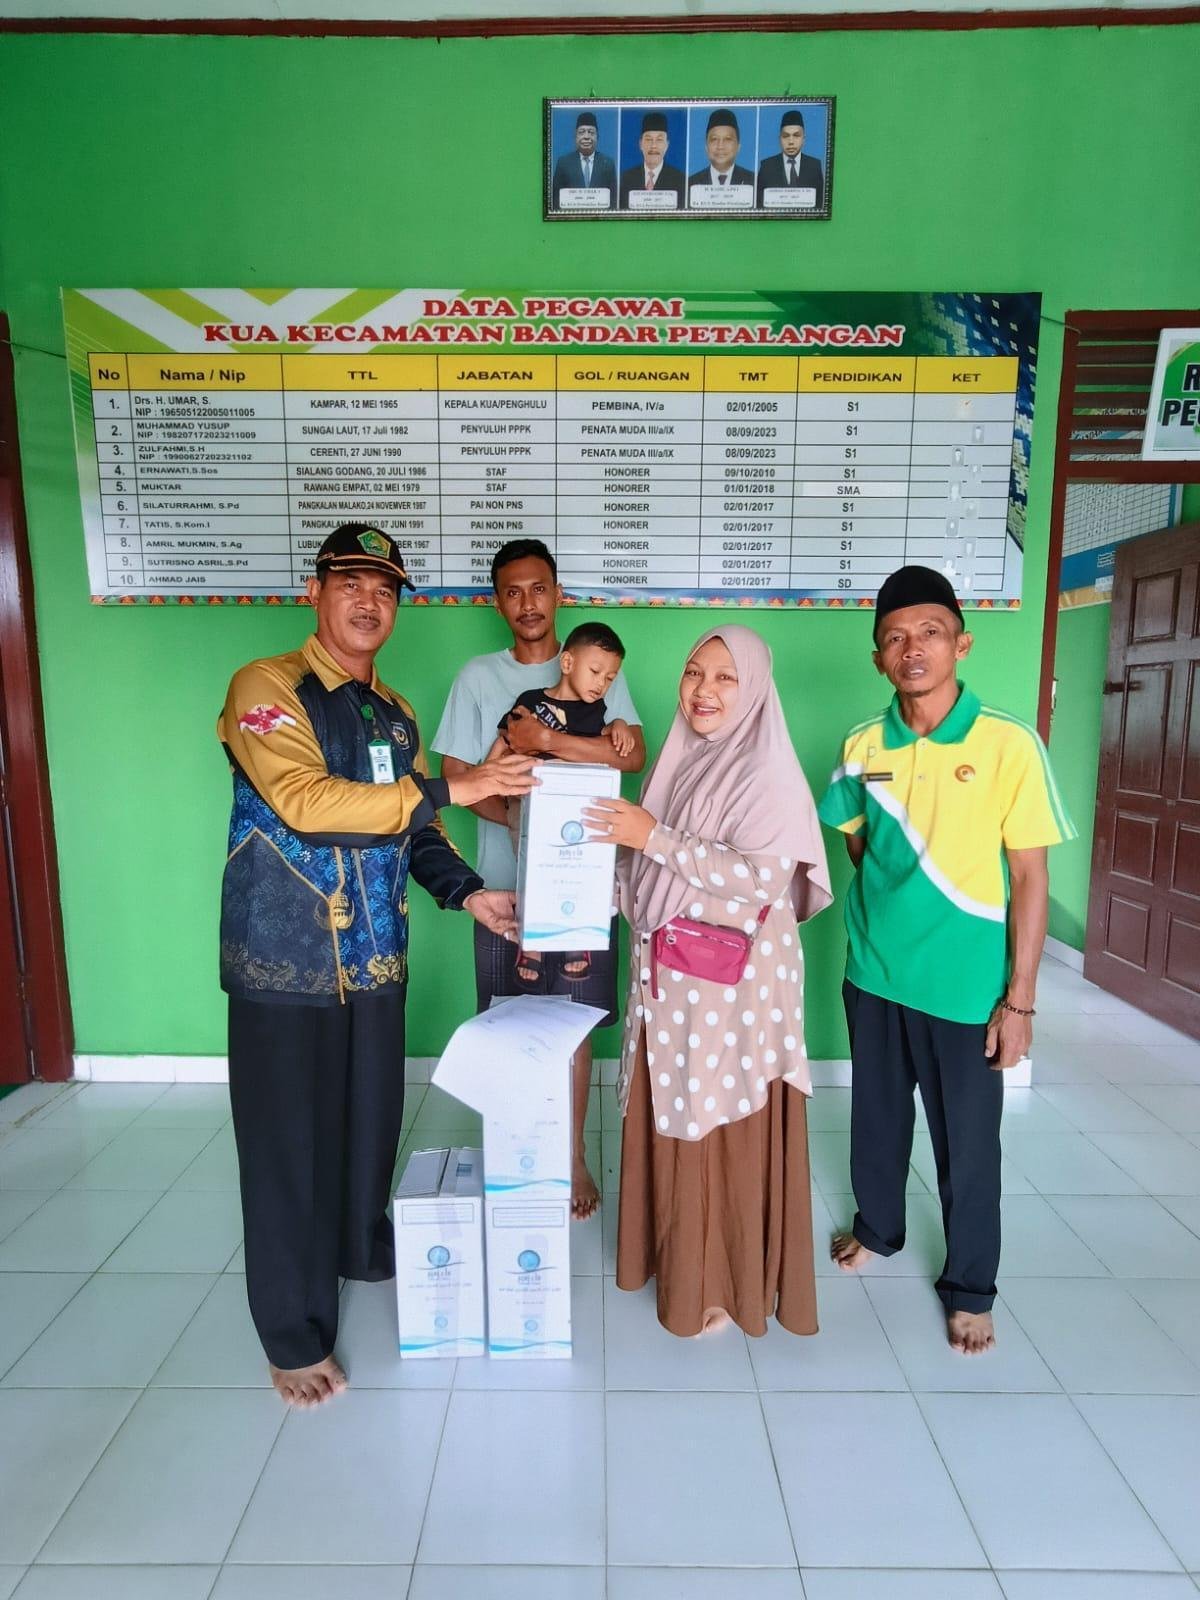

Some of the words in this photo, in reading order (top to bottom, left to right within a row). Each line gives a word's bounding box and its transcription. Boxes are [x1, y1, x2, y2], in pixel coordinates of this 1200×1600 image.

[423, 300, 517, 317] DATA
[523, 300, 684, 318] PEGAWAI
[204, 325, 280, 342] KUA
[287, 325, 505, 343] KECAMATAN
[512, 326, 660, 343] BANDAR
[667, 326, 904, 345] PETALANGAN
[98, 368, 120, 381] No
[159, 368, 205, 381] Nama
[209, 369, 215, 381] /
[219, 369, 246, 384] Nip
[347, 370, 378, 381] TTL
[456, 371, 533, 381] JABATAN
[574, 371, 605, 381] GOL
[608, 371, 613, 381] /
[616, 371, 690, 381] RUANGAN
[738, 372, 769, 382] TMT
[813, 372, 903, 382] PENDIDIKAN
[952, 373, 982, 383] KET
[108, 398, 120, 410] 1.
[134, 395, 154, 405] Drs.
[155, 396, 166, 405] H.
[167, 395, 200, 406] UMAR,
[310, 399, 349, 410] KAMPAR,
[350, 399, 361, 409] 12
[362, 399, 378, 409] MEI
[379, 399, 399, 409] 1965
[444, 399, 479, 409] KEPALA
[479, 399, 547, 409] KUA/PENGHULU
[591, 401, 643, 412] PEMBINA,
[645, 401, 665, 411] IV/a
[726, 401, 778, 413] 02/01/2005
[847, 401, 859, 412] S1
[135, 407, 152, 417] NIP
[160, 407, 255, 417] 196505122005011005
[1161, 400, 1200, 427] PE
[111, 424, 122, 437] 2.
[136, 422, 195, 430] MUHAMMAD
[197, 422, 230, 430] YUSUP
[301, 425, 335, 436] SUNGAI
[335, 425, 360, 436] LAUT,
[361, 425, 372, 435] 17
[372, 426, 388, 435] Juli
[389, 425, 409, 435] 1982
[460, 424, 507, 434] PENYULUH
[508, 424, 532, 434] PPPK
[581, 424, 618, 435] PENATA
[618, 425, 647, 435] MUDA
[845, 424, 858, 436] S1
[137, 430, 154, 439] NIP
[725, 426, 777, 438] 08/09/2023
[112, 443, 125, 456] 3.
[310, 447, 349, 458] CERENTI,
[350, 447, 360, 457] 27
[361, 447, 382, 457] JUNI
[383, 447, 402, 457] 1990
[461, 446, 507, 456] PENYULUH
[508, 446, 532, 456] PPPK
[580, 448, 618, 458] PENATA
[618, 448, 646, 458] MUDA
[725, 447, 777, 459] 08/09/2023
[844, 447, 857, 459] S1
[138, 453, 156, 461] NIP
[114, 464, 125, 476] 4.
[295, 466, 334, 476] SIALANG
[334, 466, 375, 477] GODANG,
[376, 466, 386, 476] 20
[387, 466, 407, 476] JULI
[408, 466, 427, 476] 1986
[485, 467, 507, 477] STAF
[604, 467, 650, 477] HONORER
[724, 467, 776, 478] 09/10/2010
[843, 468, 856, 479] S1
[115, 480, 127, 492] 5.
[141, 483, 182, 491] MUKTAR
[303, 482, 341, 493] RAWANG
[342, 482, 372, 494] EMPAT,
[373, 483, 383, 493] 02
[384, 483, 400, 493] MEI
[401, 483, 421, 493] 1979
[485, 482, 507, 492] STAF
[604, 483, 650, 493] HONORER
[723, 483, 775, 494] 01/01/2018
[836, 485, 861, 495] SMA
[117, 500, 128, 512] 6.
[142, 502, 216, 510] SILATURRAHMI,
[297, 500, 338, 511] PANGKALAN
[375, 501, 412, 510] NOVEMVER
[470, 500, 484, 509] PAI
[485, 500, 504, 510] NON
[506, 500, 524, 510] PNS
[604, 502, 650, 512] HONORER
[723, 502, 775, 512] 02/01/2017
[842, 502, 854, 513] S1
[118, 517, 130, 529] 7.
[144, 521, 173, 529] TATIS,
[390, 520, 407, 529] JUNI
[408, 520, 424, 529] 1991
[470, 520, 484, 530] PAI
[485, 520, 505, 530] NON
[506, 520, 524, 530] PNS
[603, 520, 649, 530] HONORER
[722, 522, 774, 532] 02/01/2017
[841, 521, 853, 532] S1
[119, 536, 131, 548] 8.
[145, 540, 175, 548] AMRIL
[177, 540, 219, 549] MUKMIN,
[414, 540, 430, 549] 1967
[471, 540, 484, 549] PAI
[603, 540, 650, 550] HONORER
[722, 541, 773, 551] 02/01/2017
[840, 540, 852, 551] S1
[121, 555, 133, 567] 9.
[147, 559, 196, 567] SUTRISNO
[410, 558, 426, 567] 1992
[471, 558, 484, 566] PAI
[602, 559, 648, 569] HONORER
[721, 559, 773, 569] 02/01/2017
[839, 559, 851, 570] S1
[119, 574, 137, 585] 10.
[185, 576, 207, 584] JAIS
[414, 574, 430, 583] 1977
[471, 575, 485, 583] PAI
[602, 575, 648, 585] HONORER
[721, 576, 772, 586] 02/01/2017
[837, 578, 852, 589] SD
